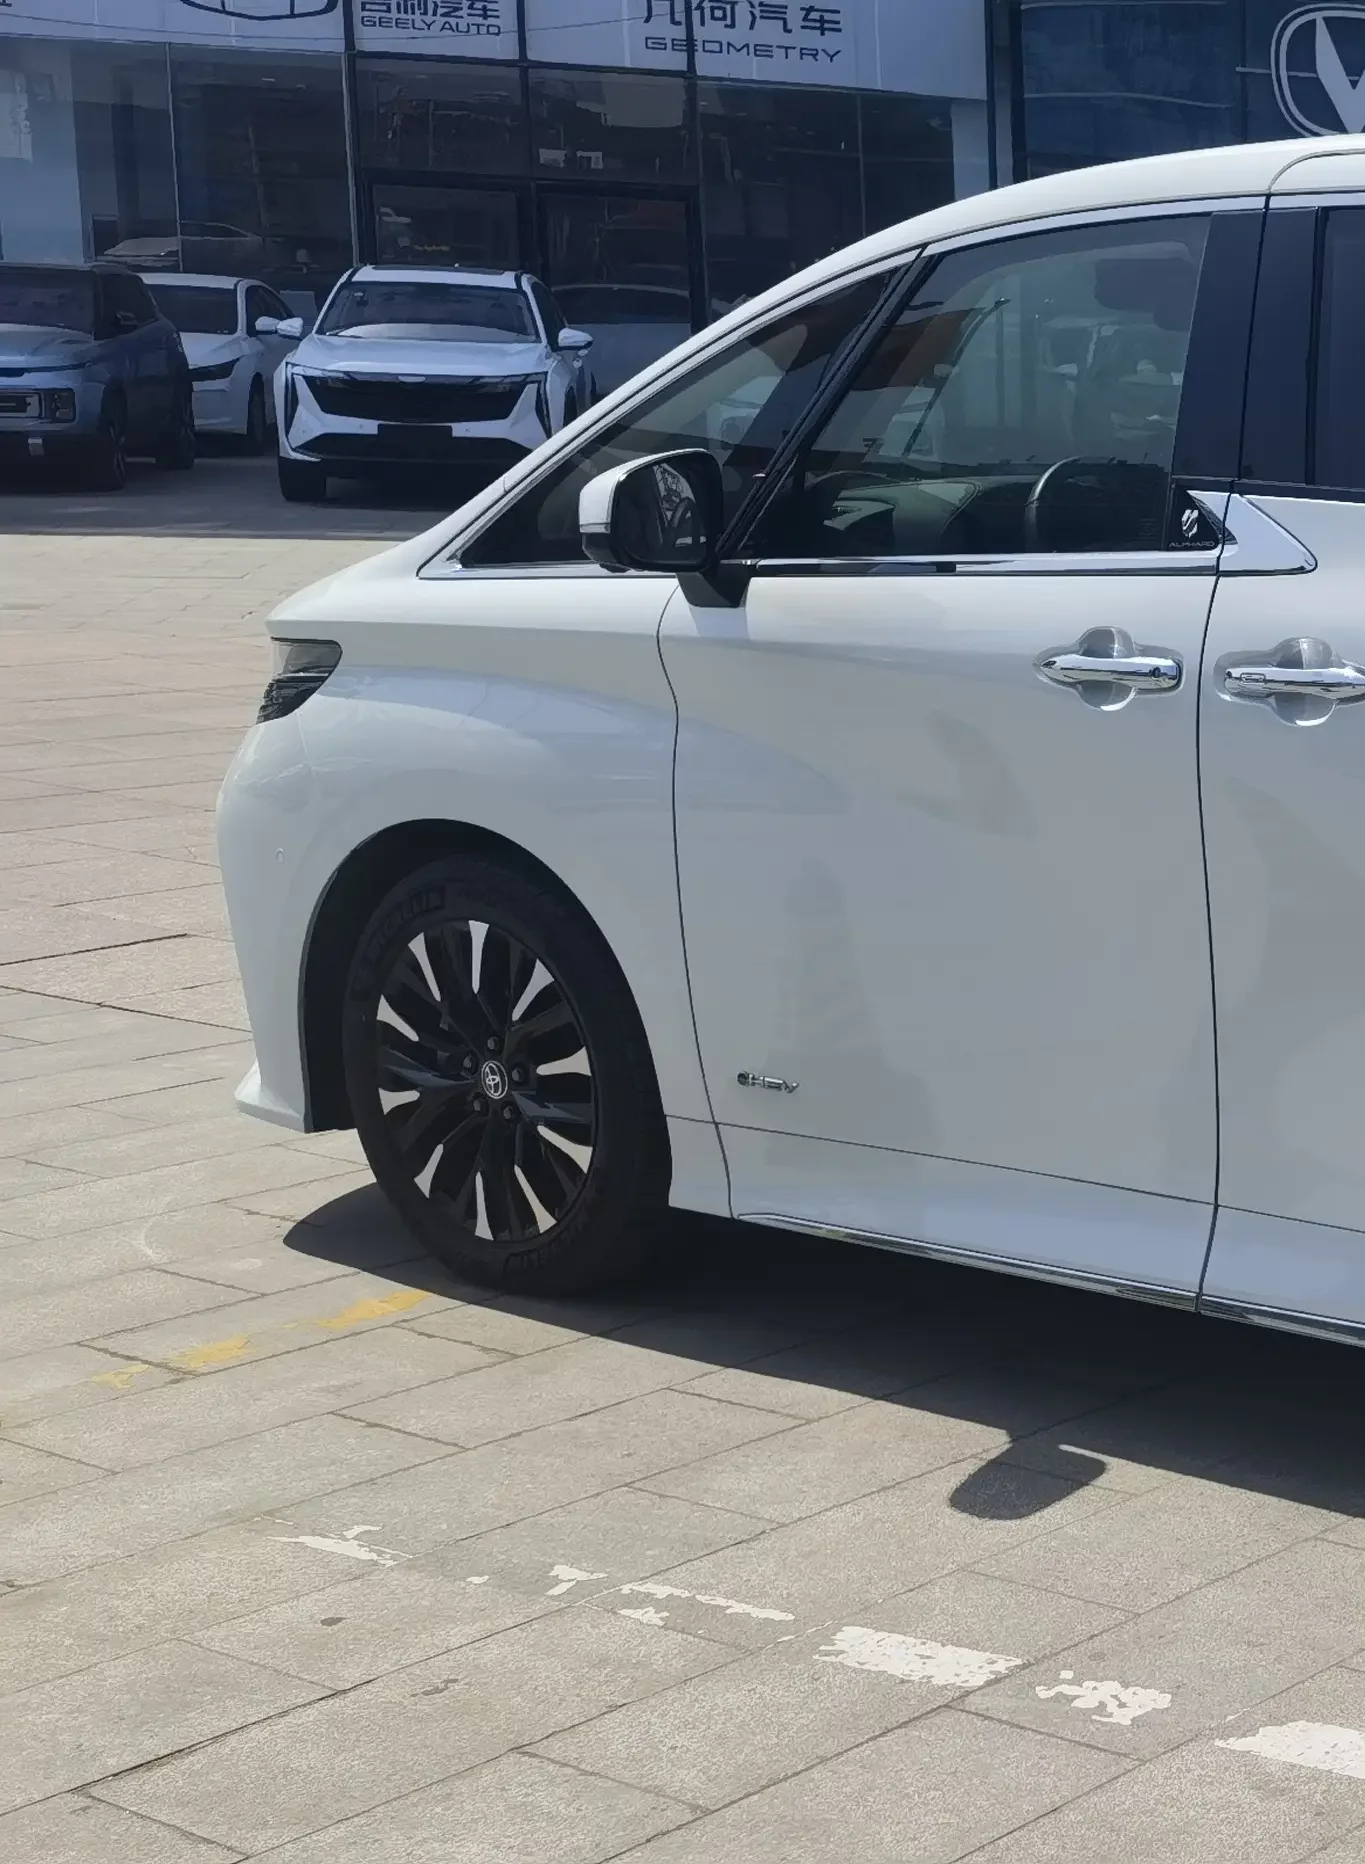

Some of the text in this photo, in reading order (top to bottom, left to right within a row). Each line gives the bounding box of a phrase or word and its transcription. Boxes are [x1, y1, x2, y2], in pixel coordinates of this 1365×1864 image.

[361, 15, 501, 36] GEELY AUTO
[644, 37, 842, 63] GEOMETRY
